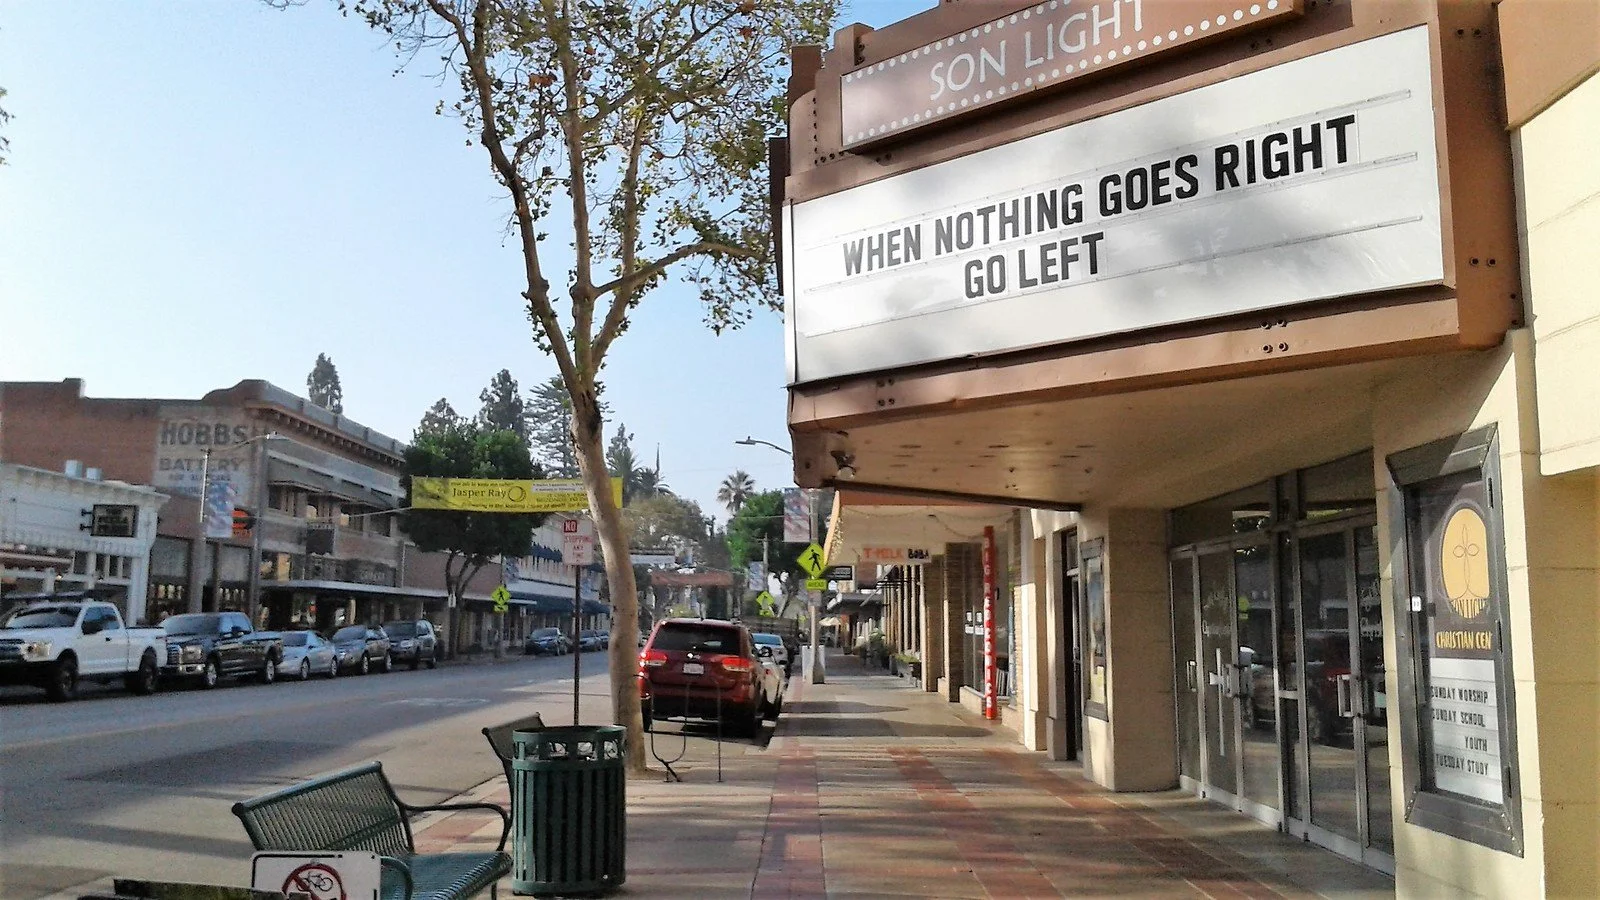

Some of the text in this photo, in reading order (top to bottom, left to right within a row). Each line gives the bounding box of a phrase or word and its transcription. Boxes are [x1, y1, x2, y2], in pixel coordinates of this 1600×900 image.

[929, 0, 1143, 101] SON LIGHT
[842, 114, 1355, 276] WHEN NOTHING GOES RIGHT
[964, 231, 1104, 299] GO LEFT
[160, 422, 250, 446] HOBBS
[452, 487, 507, 499] Jasper Ray
[565, 520, 576, 532] NO
[1436, 630, 1493, 650] CHRISTIAN CEN
[1431, 686, 1488, 704] SUNDAY WORSHIP
[1460, 711, 1486, 728] SCHOOL
[1464, 735, 1487, 752] YOUTH
[1435, 753, 1488, 775] TUESDAY STUDY
